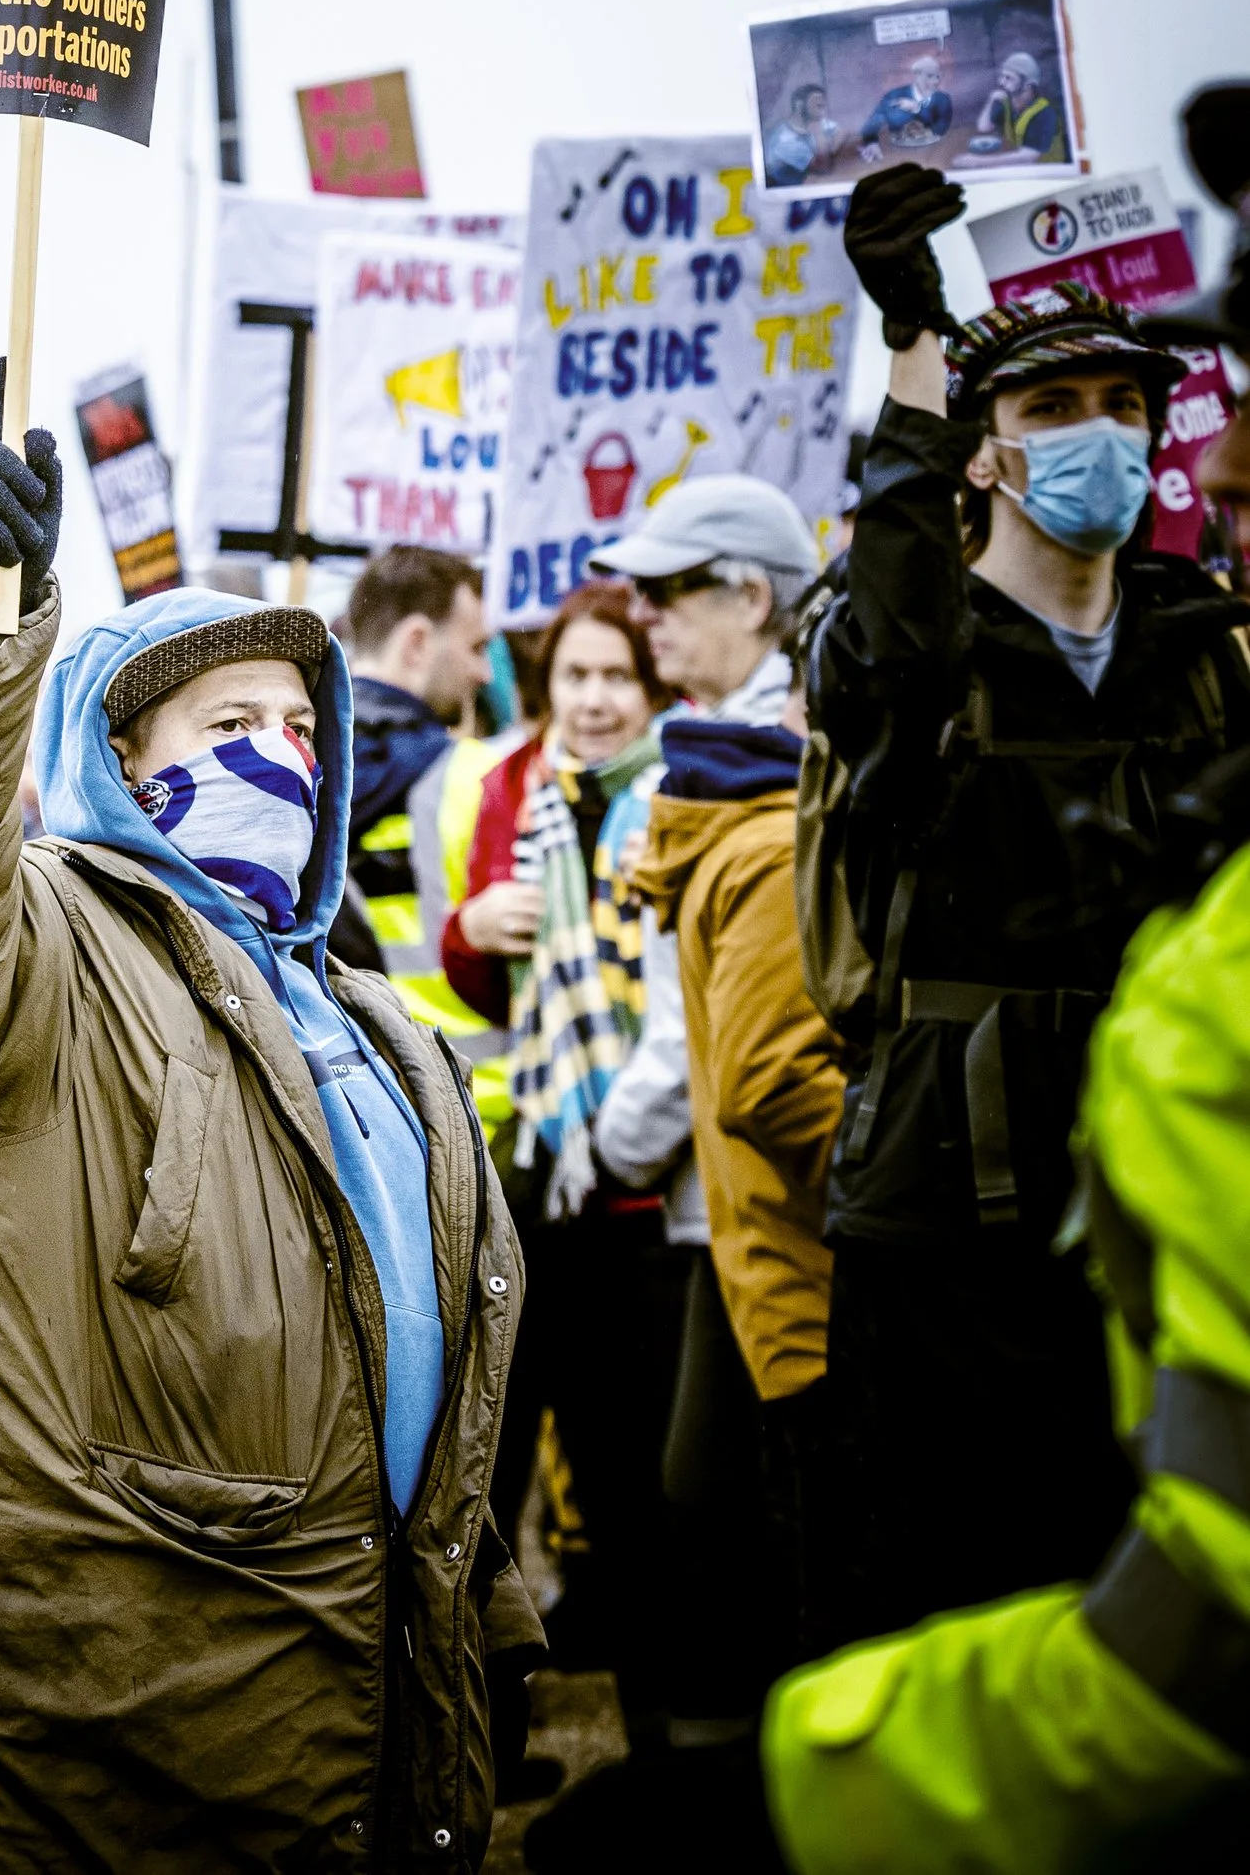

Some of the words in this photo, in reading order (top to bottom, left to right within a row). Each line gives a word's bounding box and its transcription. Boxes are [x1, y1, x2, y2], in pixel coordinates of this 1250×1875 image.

[714, 168, 755, 236] I
[543, 253, 658, 330] LIKE
[690, 252, 741, 302] TO
